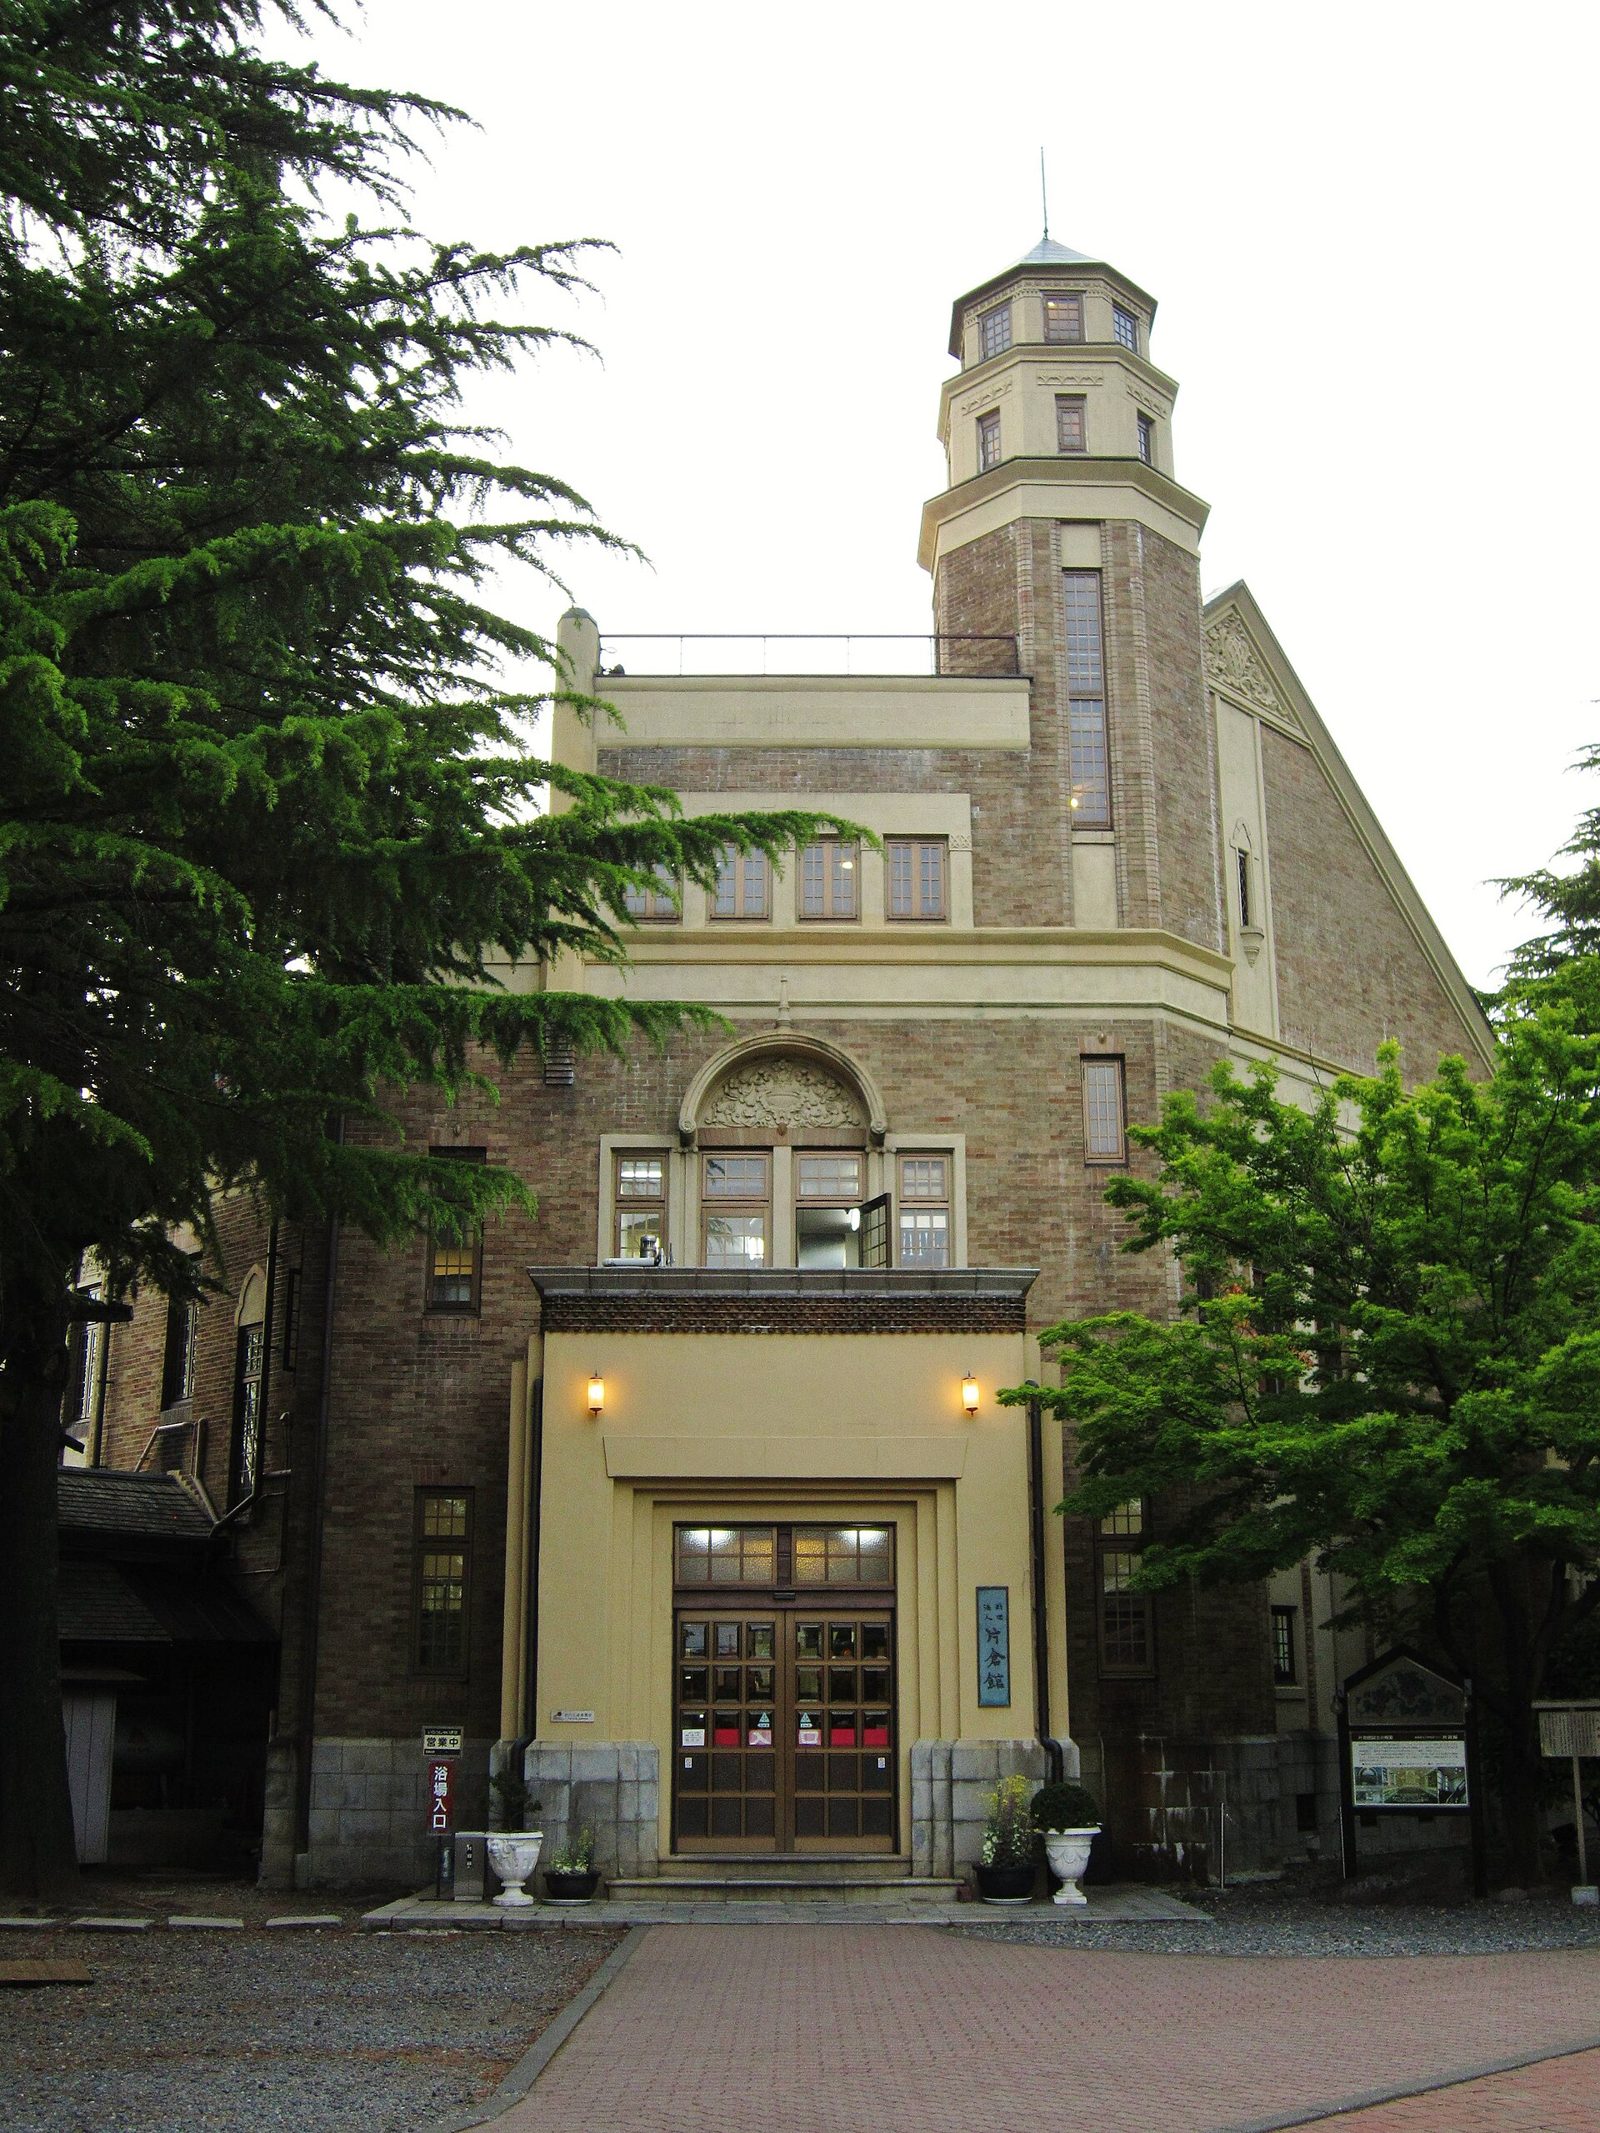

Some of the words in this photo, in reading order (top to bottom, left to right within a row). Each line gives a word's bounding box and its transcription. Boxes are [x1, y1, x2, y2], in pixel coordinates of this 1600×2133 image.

[984, 1627, 1006, 1690] 片倉館
[426, 1736, 459, 1748] 営業中
[433, 1766, 448, 1829] 浴場入口
